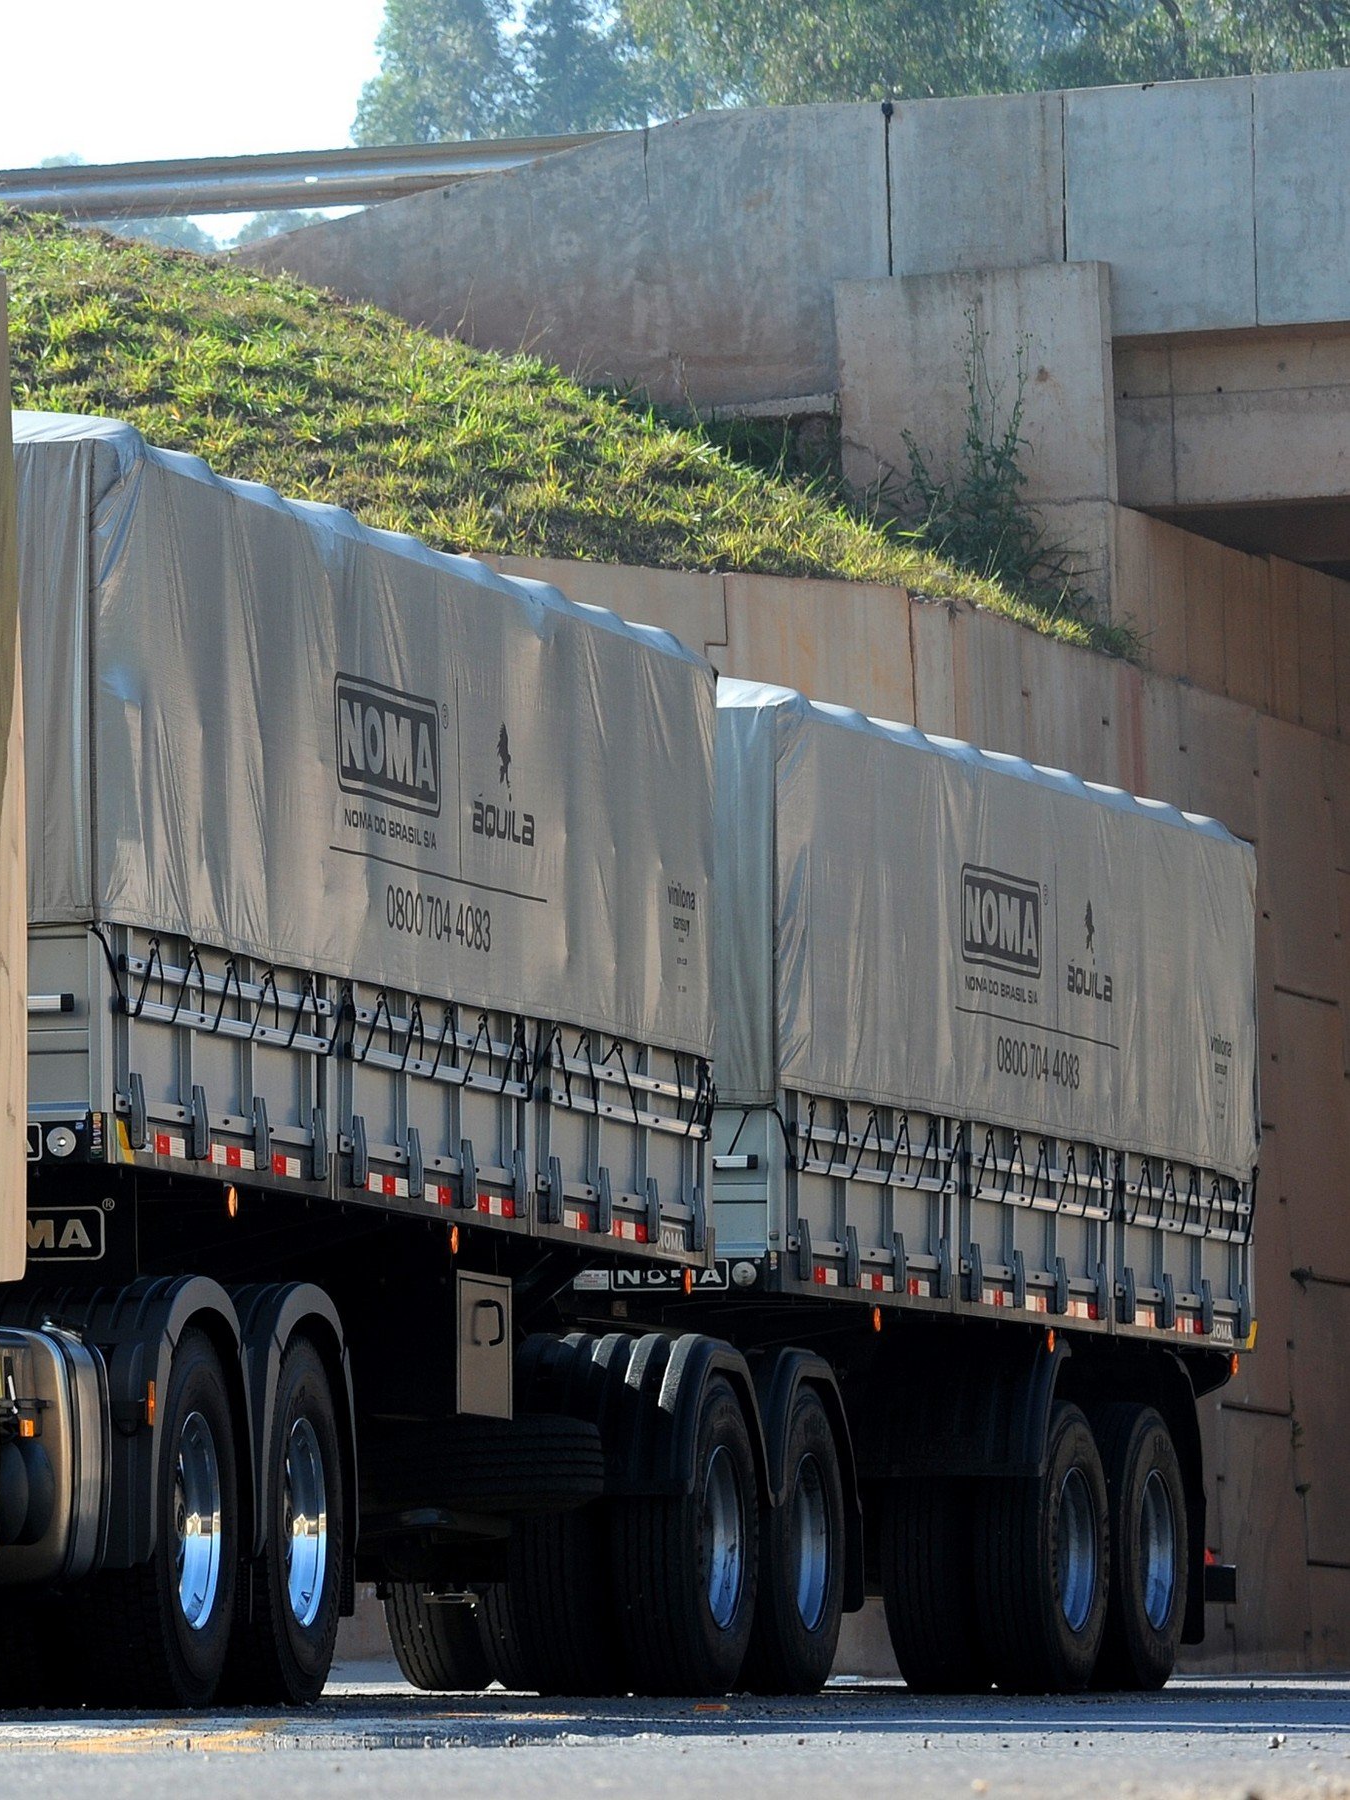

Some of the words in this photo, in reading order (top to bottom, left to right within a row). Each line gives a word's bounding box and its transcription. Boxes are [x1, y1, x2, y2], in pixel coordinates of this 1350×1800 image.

[339, 697, 437, 793] NOMA
[344, 808, 373, 831] NOMA
[374, 815, 387, 836] DO
[389, 820, 422, 846] BRASIL
[386, 885, 424, 936] 0800
[427, 895, 452, 943] 704
[456, 903, 492, 953] 4083
[965, 884, 1039, 959] NOMA
[997, 1036, 1029, 1078] 0800
[1030, 1045, 1049, 1081] 704
[1052, 1051, 1081, 1090] 4083
[27, 1219, 92, 1249] MA
